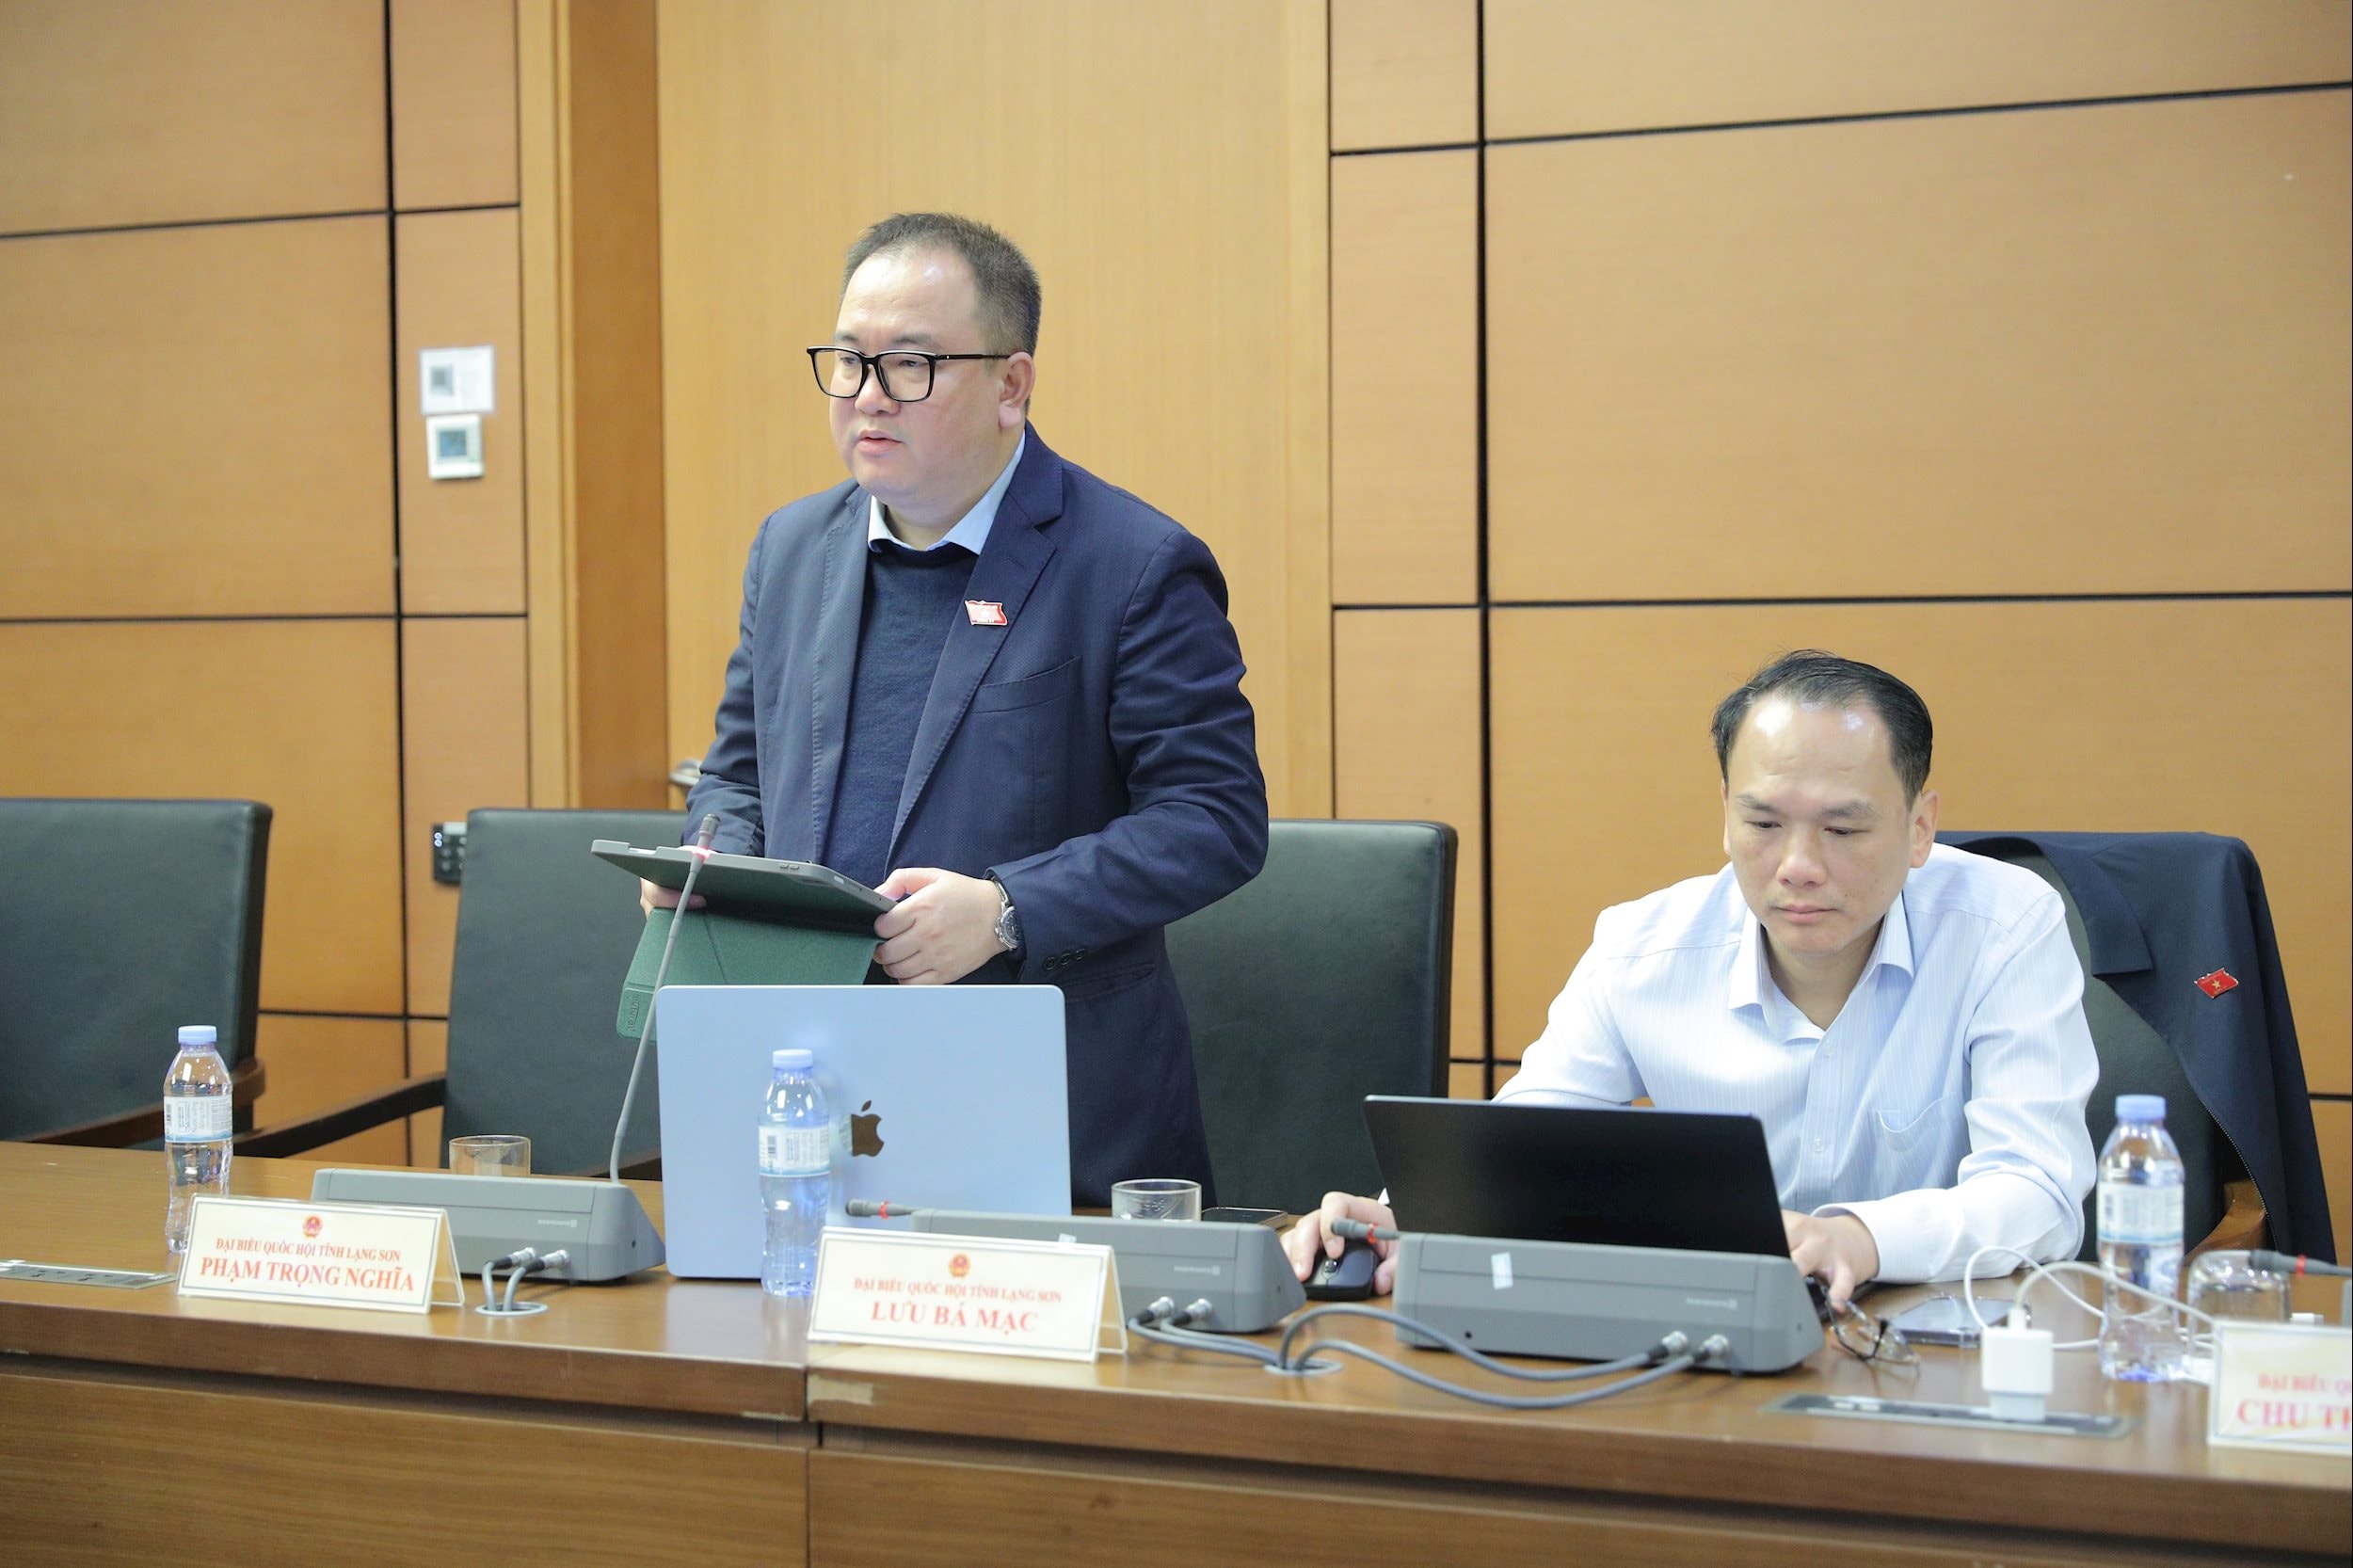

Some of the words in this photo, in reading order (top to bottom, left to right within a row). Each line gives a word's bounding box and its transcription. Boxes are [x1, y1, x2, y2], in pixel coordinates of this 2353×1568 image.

[216, 1238, 235, 1253] ĐẠI
[264, 1239, 295, 1256] QUỐC
[296, 1242, 317, 1258] HỘI
[346, 1247, 376, 1262] LẠNG
[378, 1249, 401, 1262] SƠN
[200, 1256, 262, 1283] PHẠM
[266, 1262, 341, 1288] TRỌNG
[344, 1266, 413, 1291] NGHĨA
[855, 1278, 874, 1292] ĐẠI
[1001, 1288, 1034, 1303] LẠNG
[871, 1300, 927, 1324] LƯU
[934, 1301, 966, 1326] BÁ
[976, 1308, 1038, 1336] MẠC
[2236, 1400, 2309, 1430] CHU
